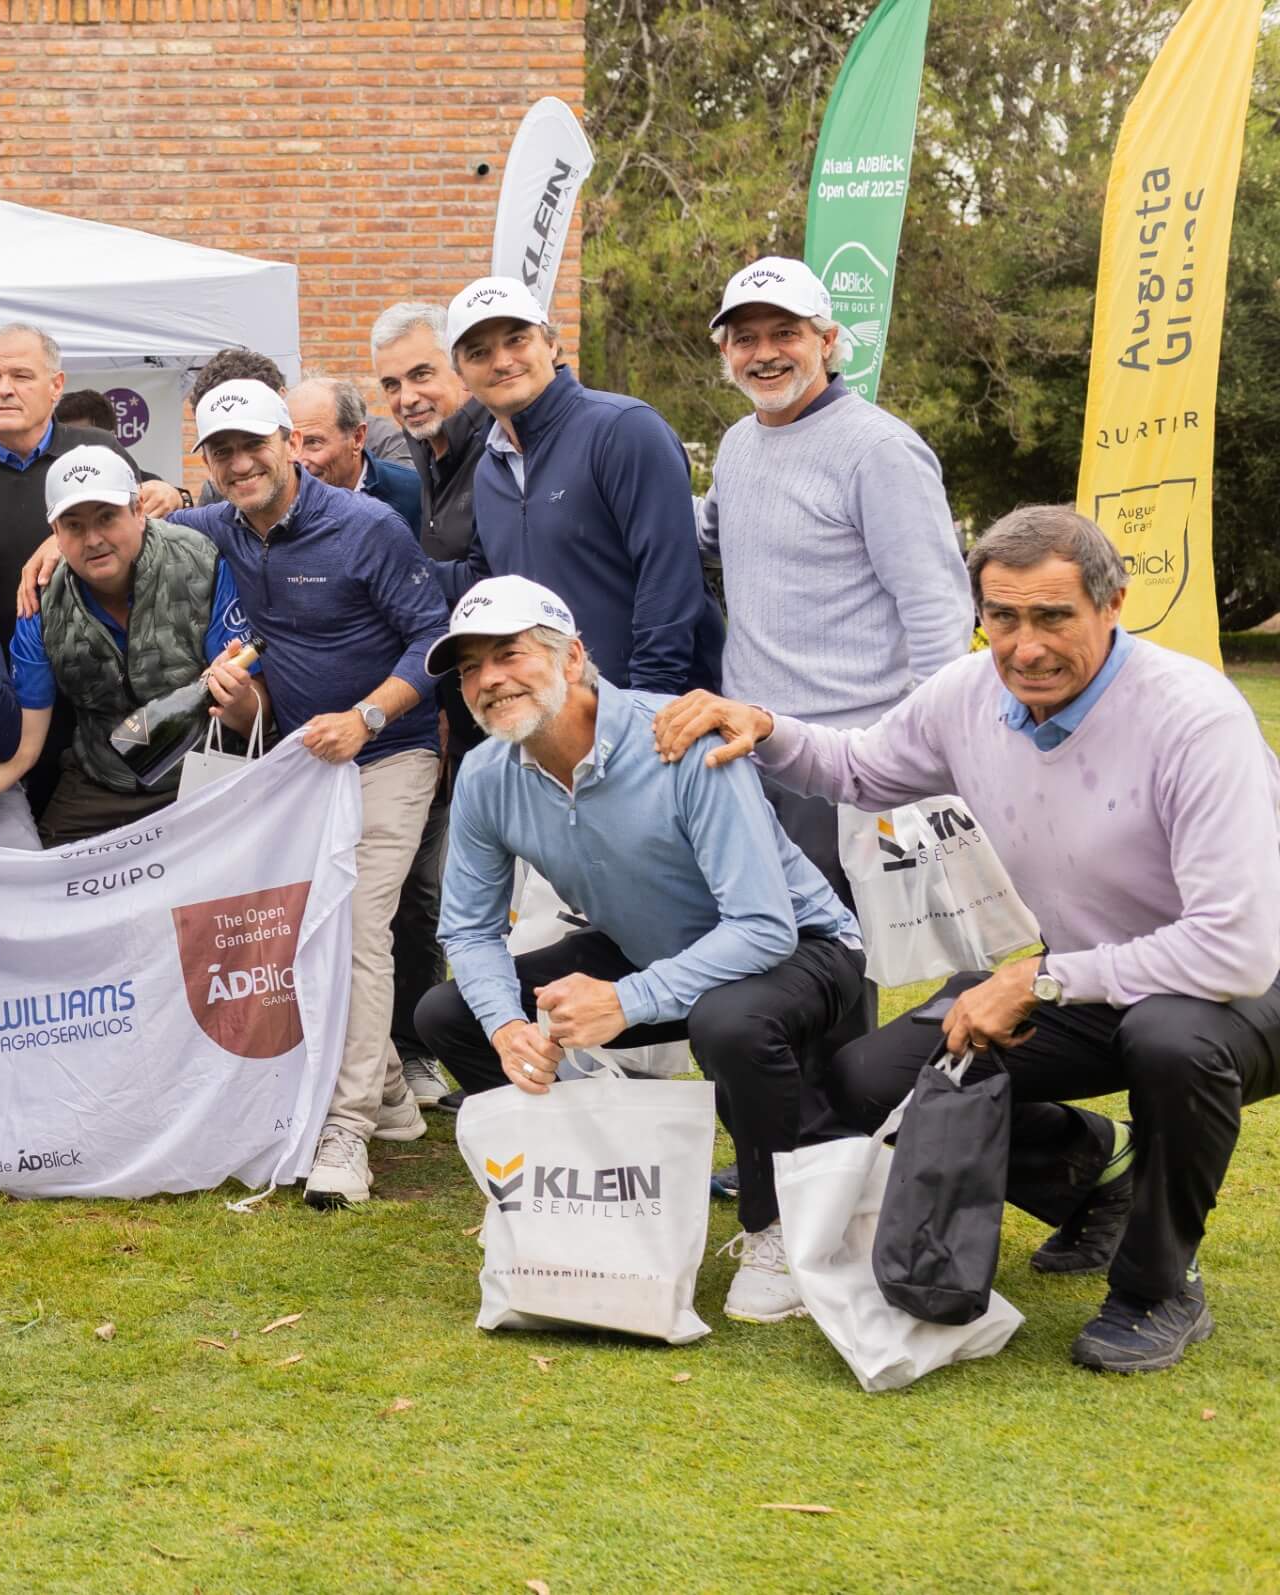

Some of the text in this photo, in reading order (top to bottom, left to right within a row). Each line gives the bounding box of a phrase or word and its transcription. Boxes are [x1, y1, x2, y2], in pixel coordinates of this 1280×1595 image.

[817, 179, 906, 201] Open Golf 2025
[740, 270, 786, 288] Callaway
[831, 271, 873, 293] ADBlick
[467, 289, 509, 309] Callaway
[210, 395, 249, 412] Callaway
[63, 465, 101, 482] Callaway
[66, 863, 165, 897] EQUIPO
[214, 906, 285, 930] The Open
[215, 922, 292, 949] Ganadería
[207, 962, 297, 1005] ADBlic
[0, 1016, 133, 1053] AGROSERVICIOS
[17, 1149, 83, 1172] ADBlick
[533, 1164, 662, 1203] KLEIN
[532, 1200, 662, 1218] SEMILLAS
